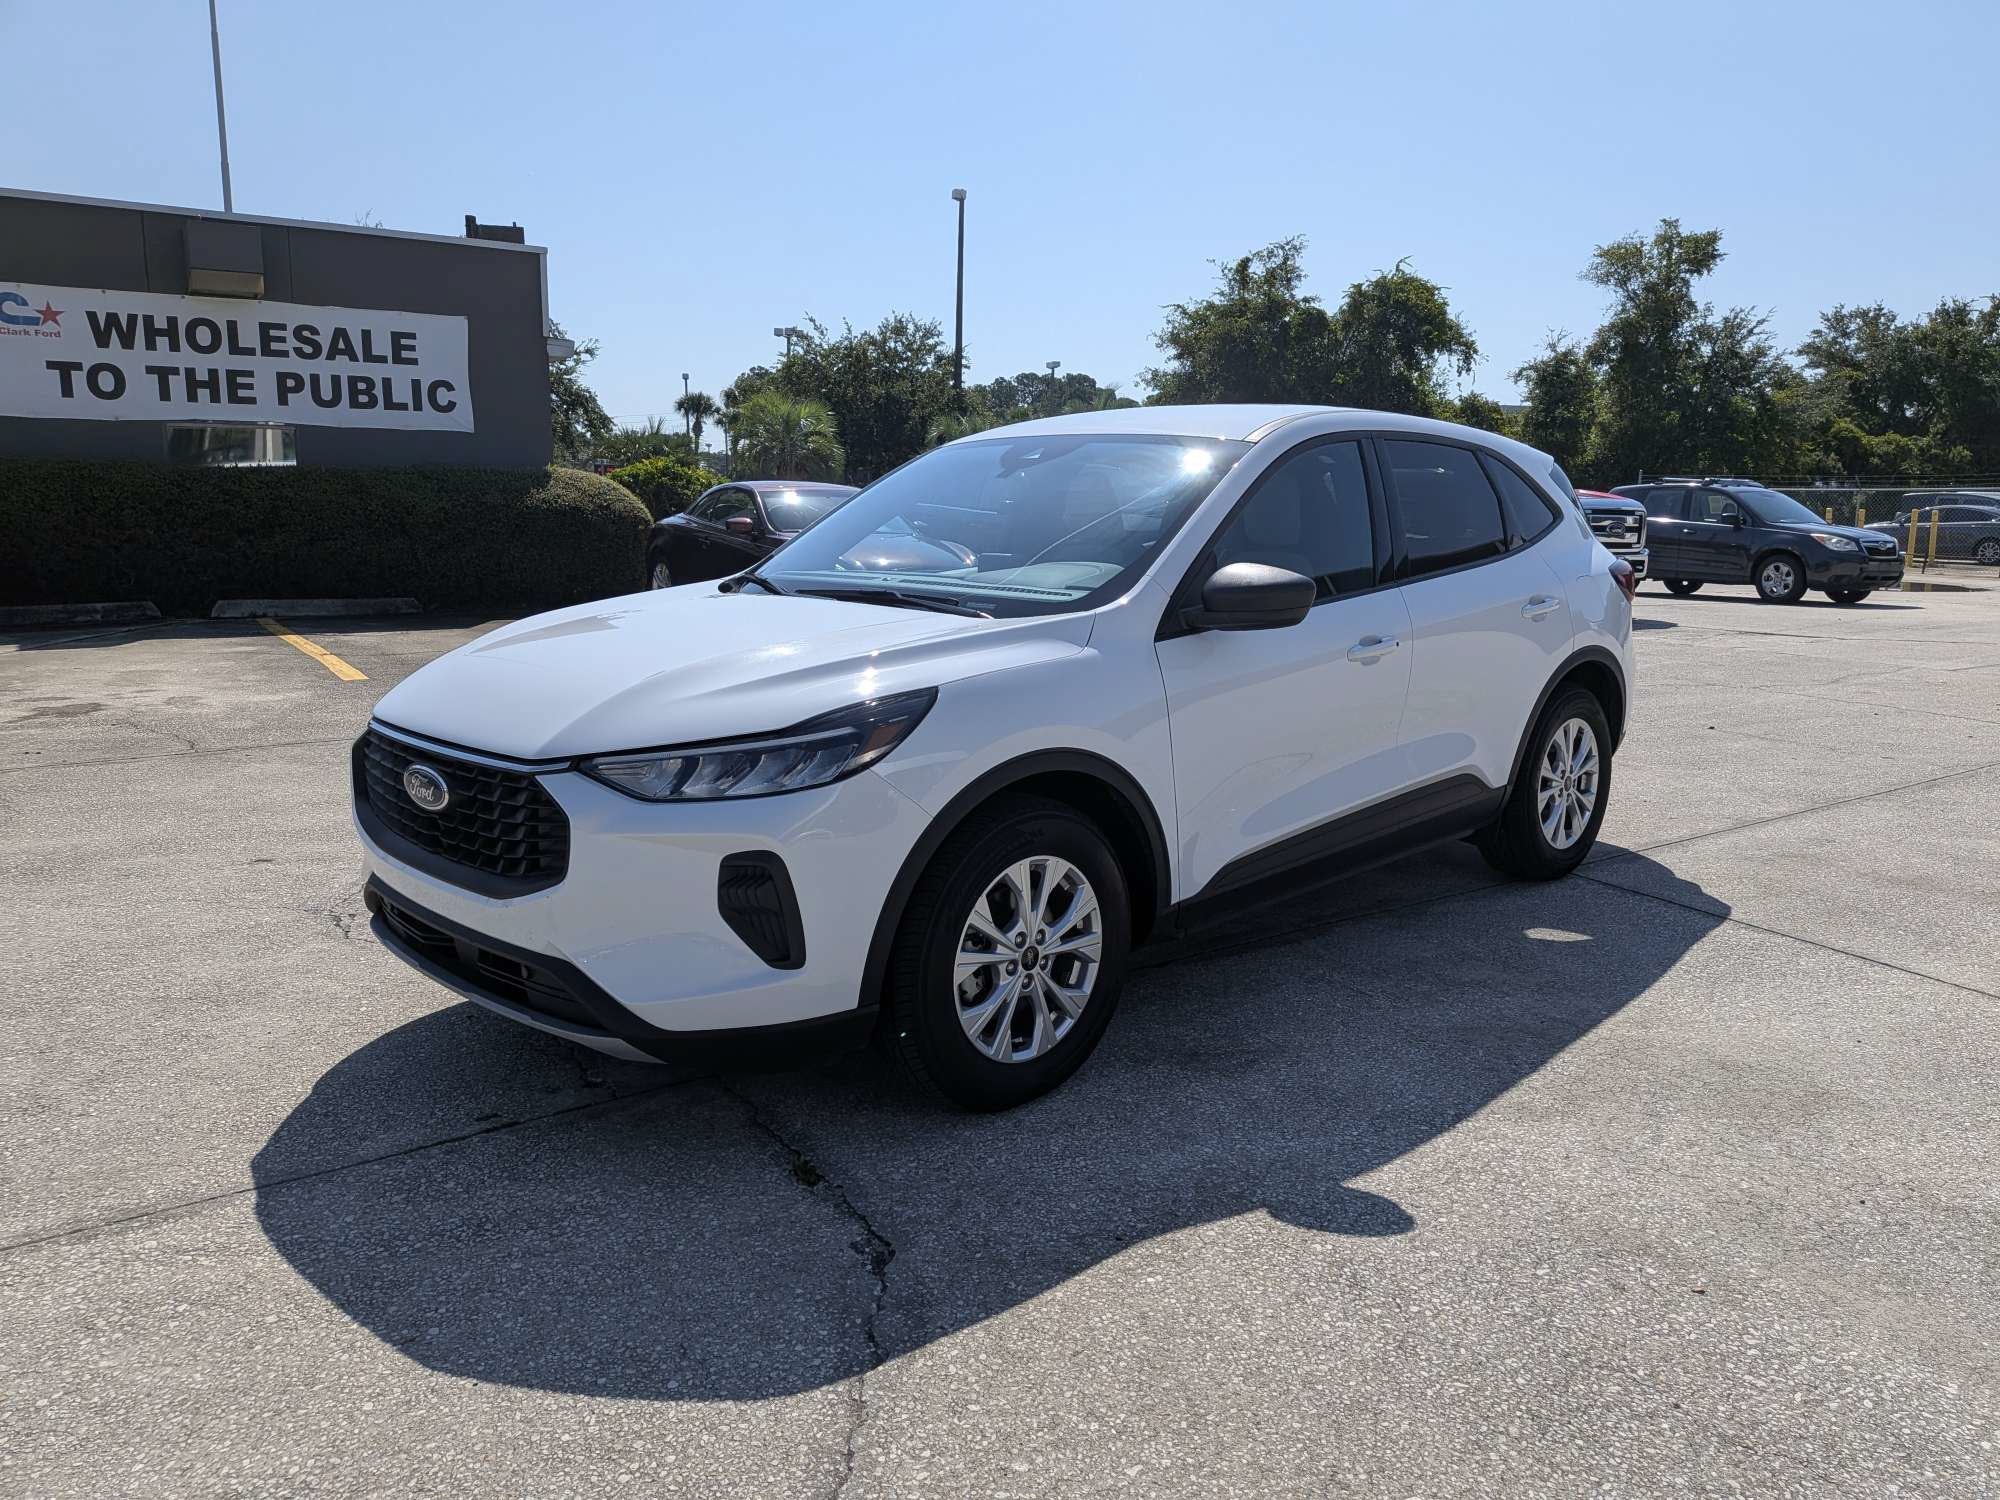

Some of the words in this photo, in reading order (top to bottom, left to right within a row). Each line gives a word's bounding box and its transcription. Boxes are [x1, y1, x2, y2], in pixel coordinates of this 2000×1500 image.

[0, 326, 31, 337] Clark
[34, 329, 62, 338] Ford
[85, 310, 419, 366] WHOLESALE
[45, 360, 127, 401] TO
[145, 365, 256, 405] THE
[276, 371, 457, 414] PUBLIC
[409, 773, 434, 801] Ford
